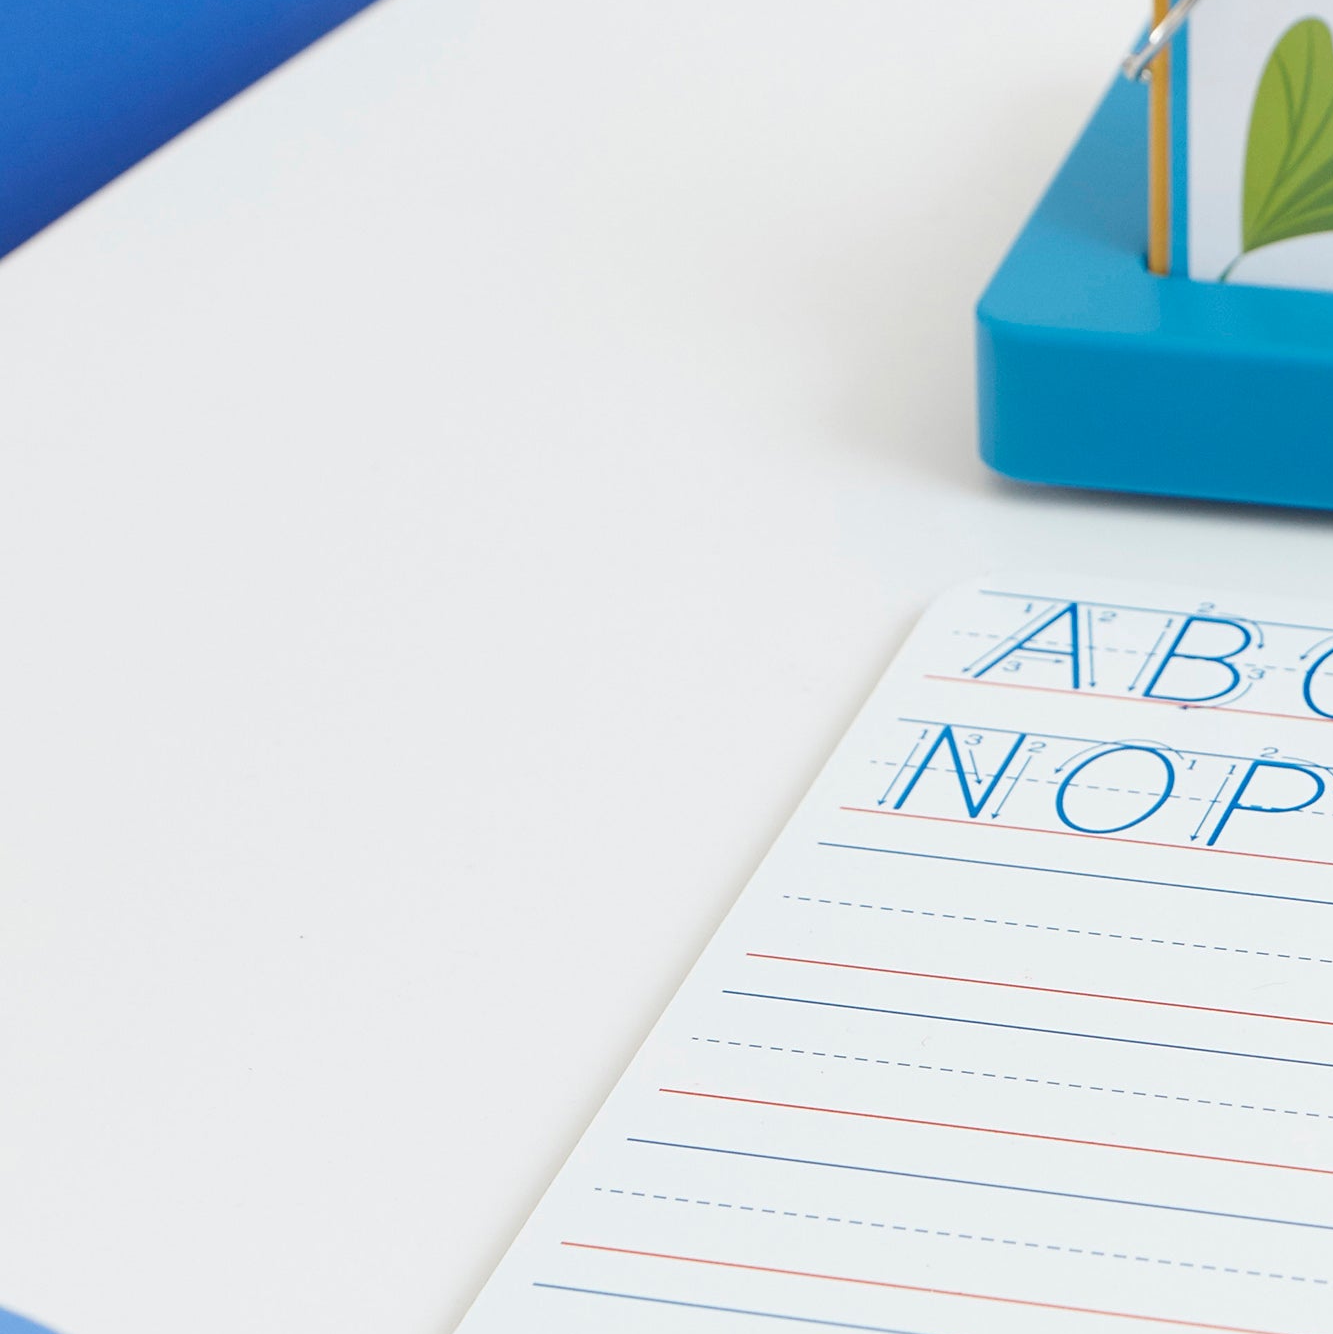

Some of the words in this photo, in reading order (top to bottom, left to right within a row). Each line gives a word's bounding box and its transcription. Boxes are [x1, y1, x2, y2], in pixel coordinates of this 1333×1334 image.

[972, 602, 1080, 690] A
[1142, 615, 1252, 702] B
[1003, 661, 1022, 674] 3
[1024, 603, 1033, 614] 1
[1098, 611, 1117, 623] 2
[1164, 618, 1174, 628] 1
[1198, 602, 1216, 614] 2
[1248, 668, 1266, 681] 3
[893, 724, 1027, 818] N
[1055, 745, 1175, 835] O
[1207, 760, 1325, 846] P
[919, 729, 928, 740] 1
[964, 734, 984, 746] 3
[1028, 741, 1047, 754] 2
[1187, 760, 1197, 770] 1
[1227, 765, 1237, 775] 1
[1260, 747, 1279, 758] 2
